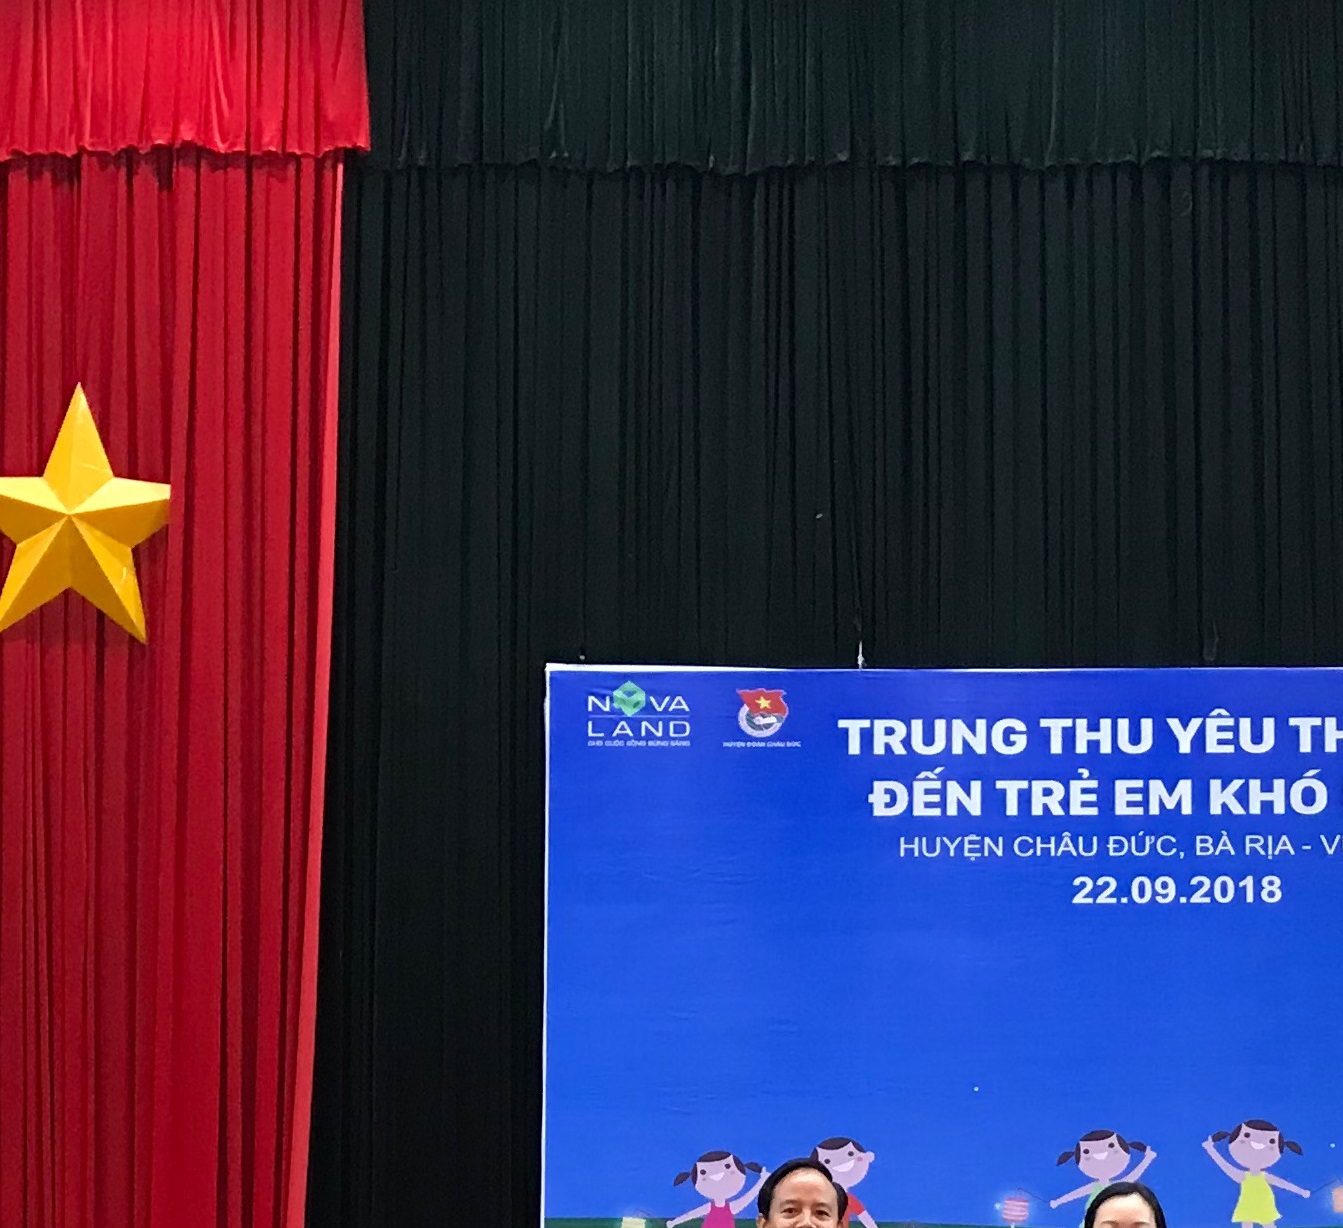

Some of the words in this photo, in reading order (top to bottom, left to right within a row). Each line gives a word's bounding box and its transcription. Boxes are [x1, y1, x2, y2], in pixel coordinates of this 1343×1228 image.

[587, 720, 691, 737] LAND
[837, 717, 1028, 756] TRUNG
[1039, 717, 1154, 755] THU
[1166, 708, 1276, 754] YÊU
[867, 766, 982, 817] ĐẾN
[995, 768, 1099, 816] TRẺ
[1114, 779, 1193, 816] EM
[1209, 768, 1328, 815] KHÓ
[899, 834, 1004, 862] HUYỆN
[1013, 831, 1098, 858] CHÂU
[1106, 830, 1185, 860] ĐỨC,
[1195, 830, 1236, 857] BÀ
[1245, 833, 1296, 860] RỊA
[1072, 875, 1283, 904] 22.09.2018
